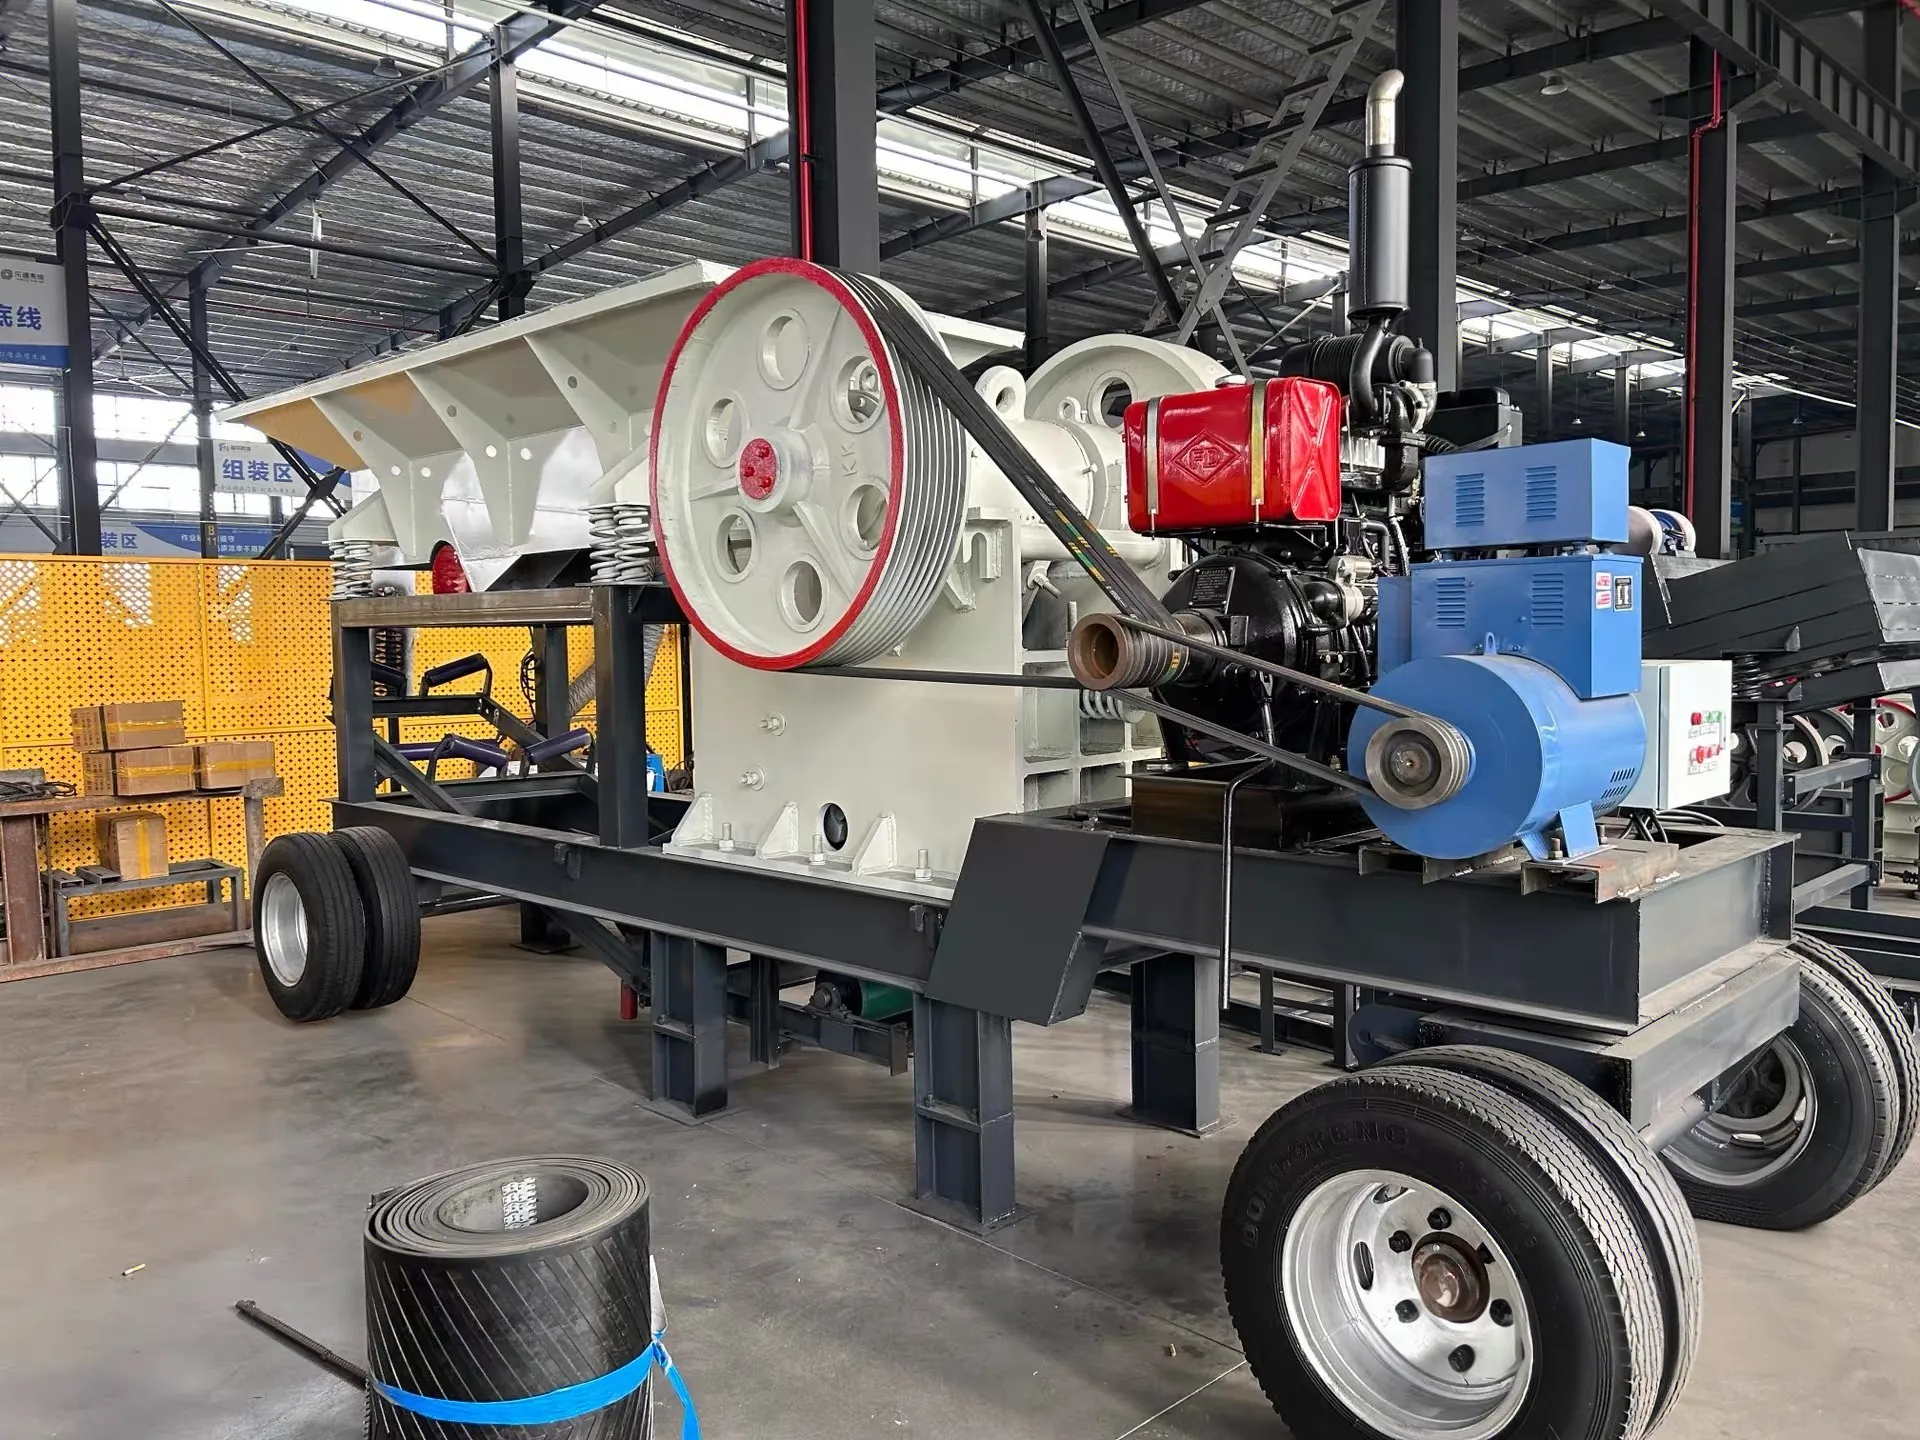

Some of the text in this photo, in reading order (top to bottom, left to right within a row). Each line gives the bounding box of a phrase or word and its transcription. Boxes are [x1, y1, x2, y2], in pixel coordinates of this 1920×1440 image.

[222, 458, 293, 483] 组装区
[208, 525, 215, 536] B
[206, 536, 217, 546] 11
